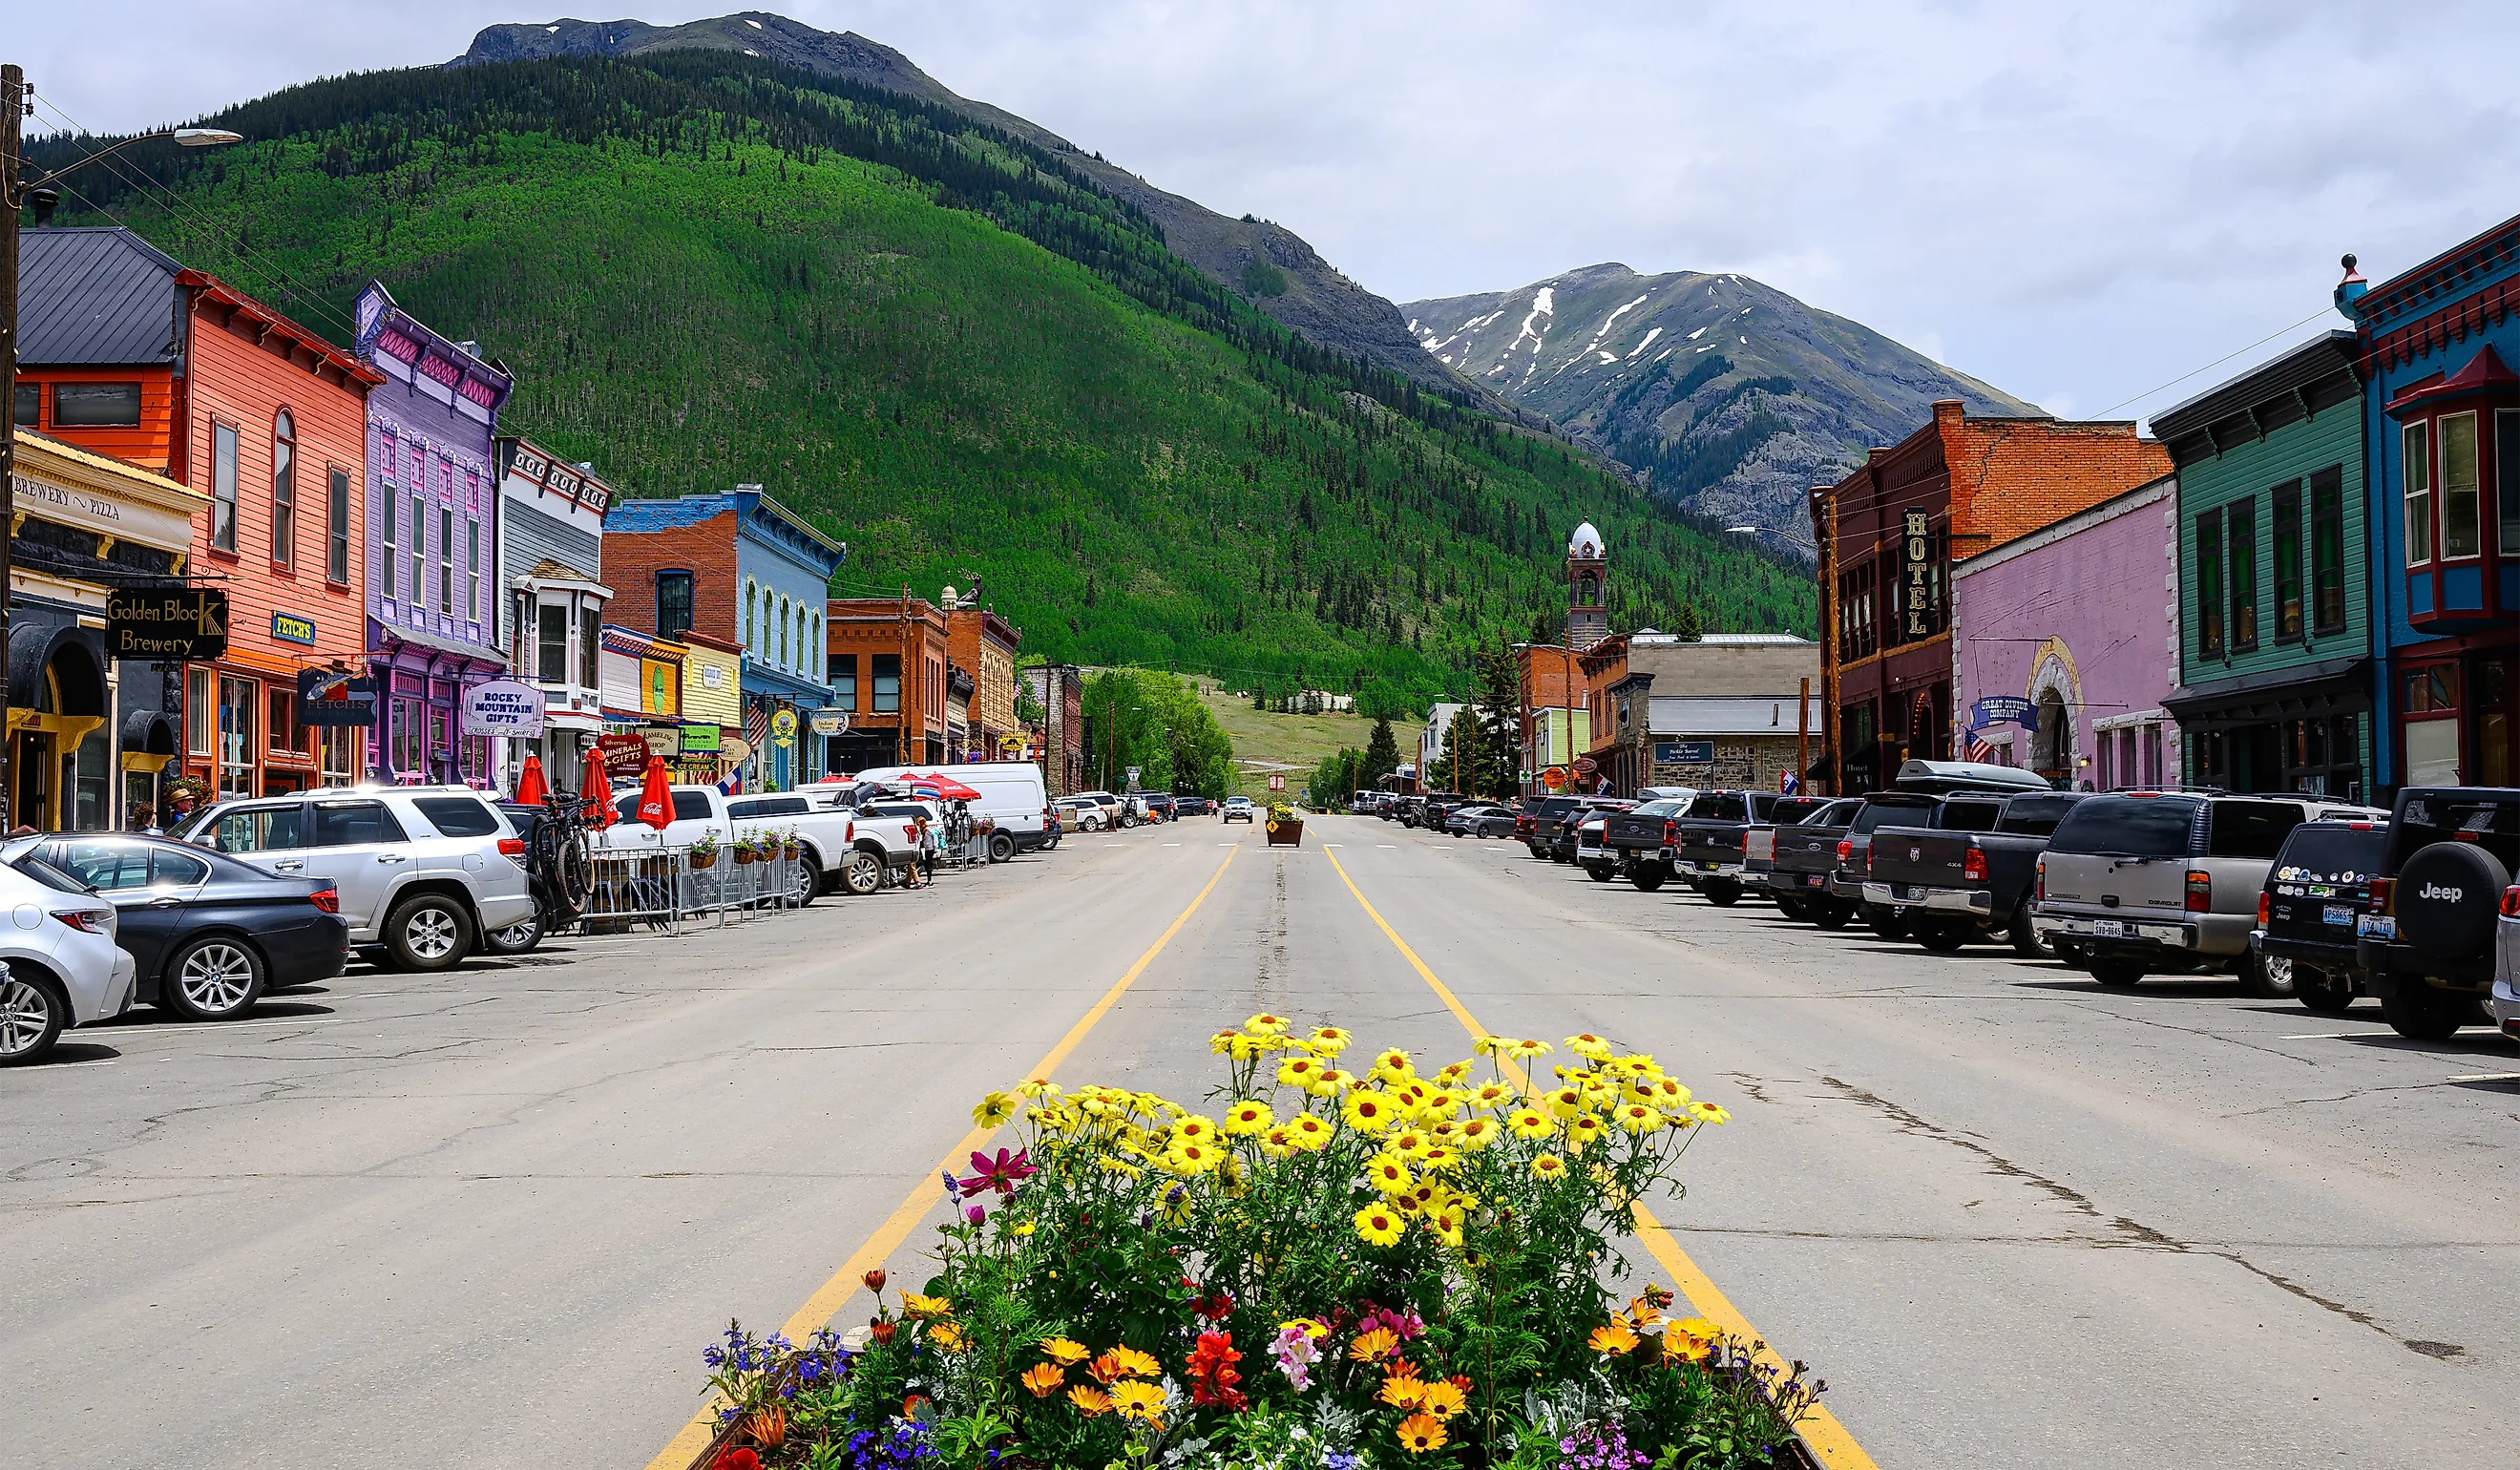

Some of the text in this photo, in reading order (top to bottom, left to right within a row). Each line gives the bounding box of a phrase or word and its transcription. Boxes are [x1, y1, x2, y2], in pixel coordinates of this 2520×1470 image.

[13, 475, 119, 520] BREWERY PIZZA
[1906, 514, 1927, 634] HOTEL
[108, 598, 160, 620] Golden
[276, 616, 311, 640] FETCH'S
[120, 630, 194, 656] Brewery
[484, 692, 523, 703] ROCKY
[475, 703, 534, 714] MOUNTAIN
[1981, 700, 2028, 711] GREAT DIVIDE
[486, 714, 519, 724] GIFTS
[1989, 709, 2021, 719] COMPANY
[612, 751, 641, 765] GIFTS
[2419, 882, 2463, 903] Jeep
[2276, 912, 2291, 921] Jeep
